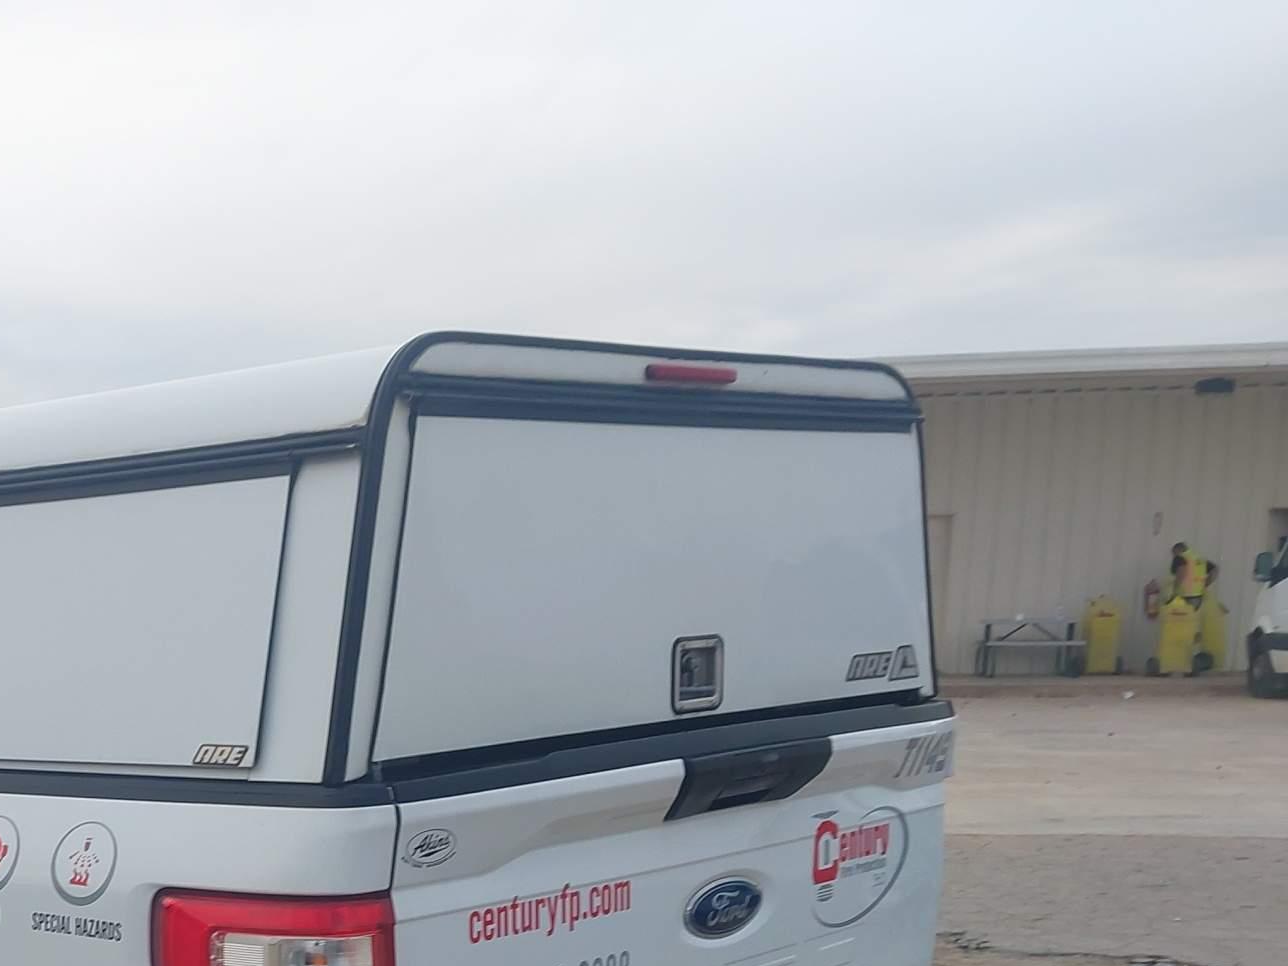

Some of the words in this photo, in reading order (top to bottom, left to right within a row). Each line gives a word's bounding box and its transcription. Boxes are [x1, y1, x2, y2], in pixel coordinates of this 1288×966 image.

[813, 820, 890, 885] Century
[32, 912, 72, 935] SPECIAL
[74, 917, 122, 942] HAZARDS
[469, 883, 631, 943] centuryfp.com
[707, 890, 752, 926] Ford
